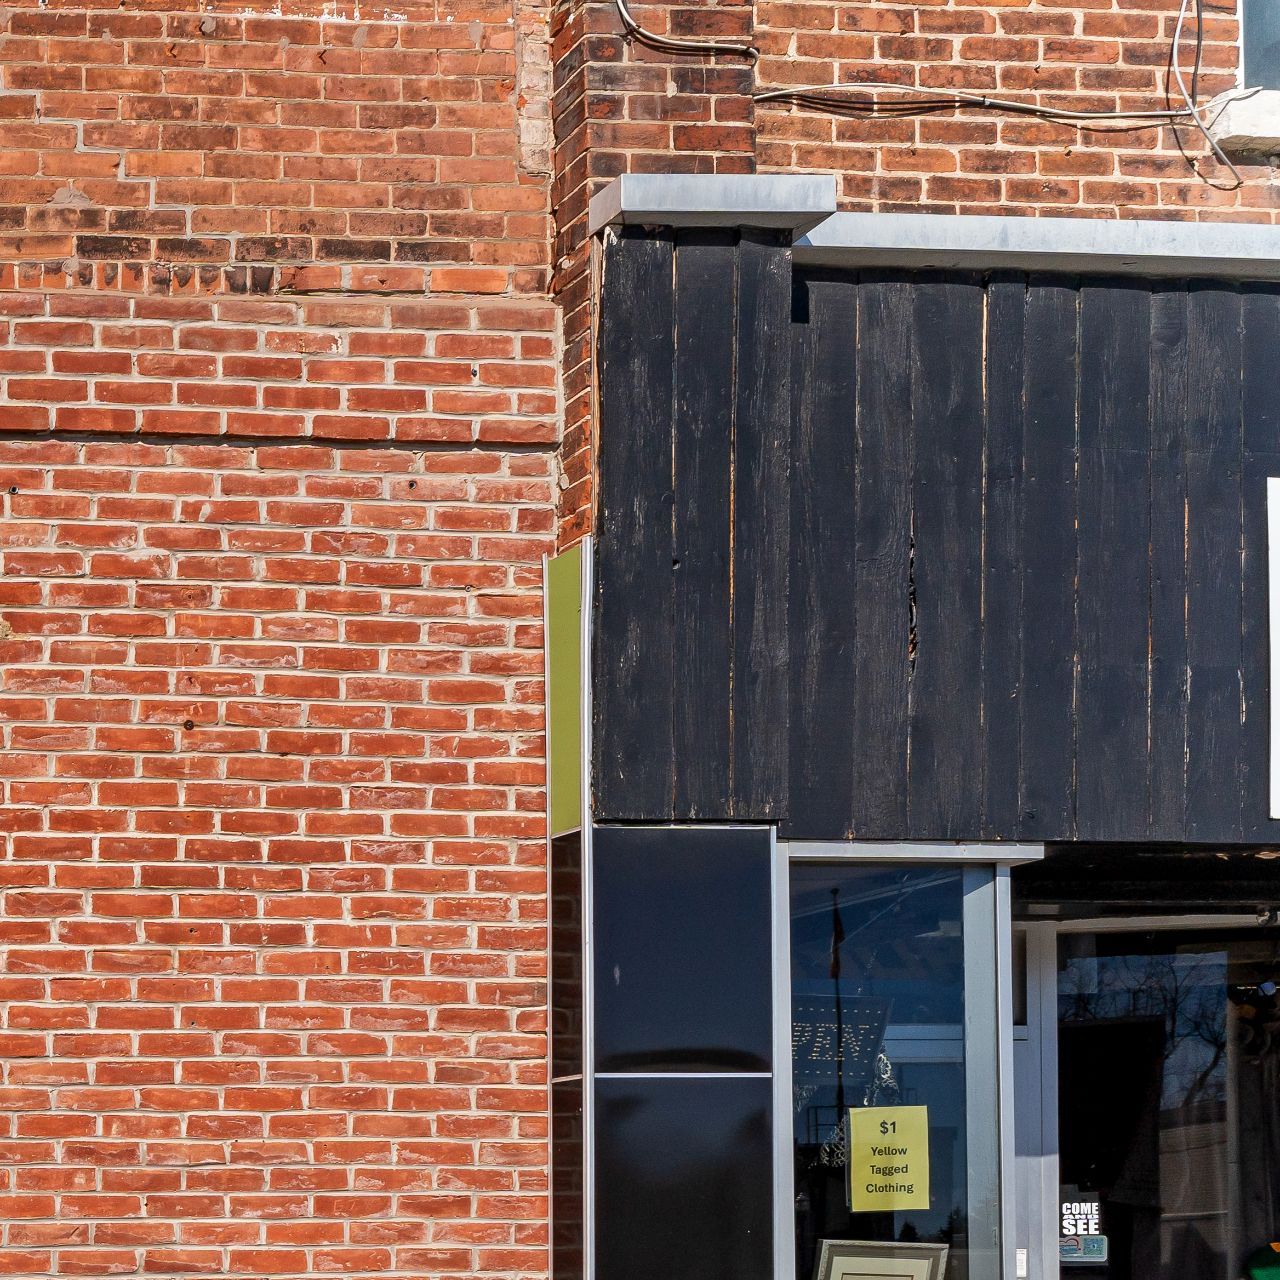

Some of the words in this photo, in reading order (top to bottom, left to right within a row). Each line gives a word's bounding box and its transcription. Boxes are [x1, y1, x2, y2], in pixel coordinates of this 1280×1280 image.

[879, 1119, 897, 1136] $1
[870, 1146, 908, 1156] Yellow
[869, 1164, 909, 1177] Tagged
[865, 1182, 915, 1194] Clothing
[1062, 1202, 1099, 1215] COME
[1062, 1219, 1100, 1236] SEE
